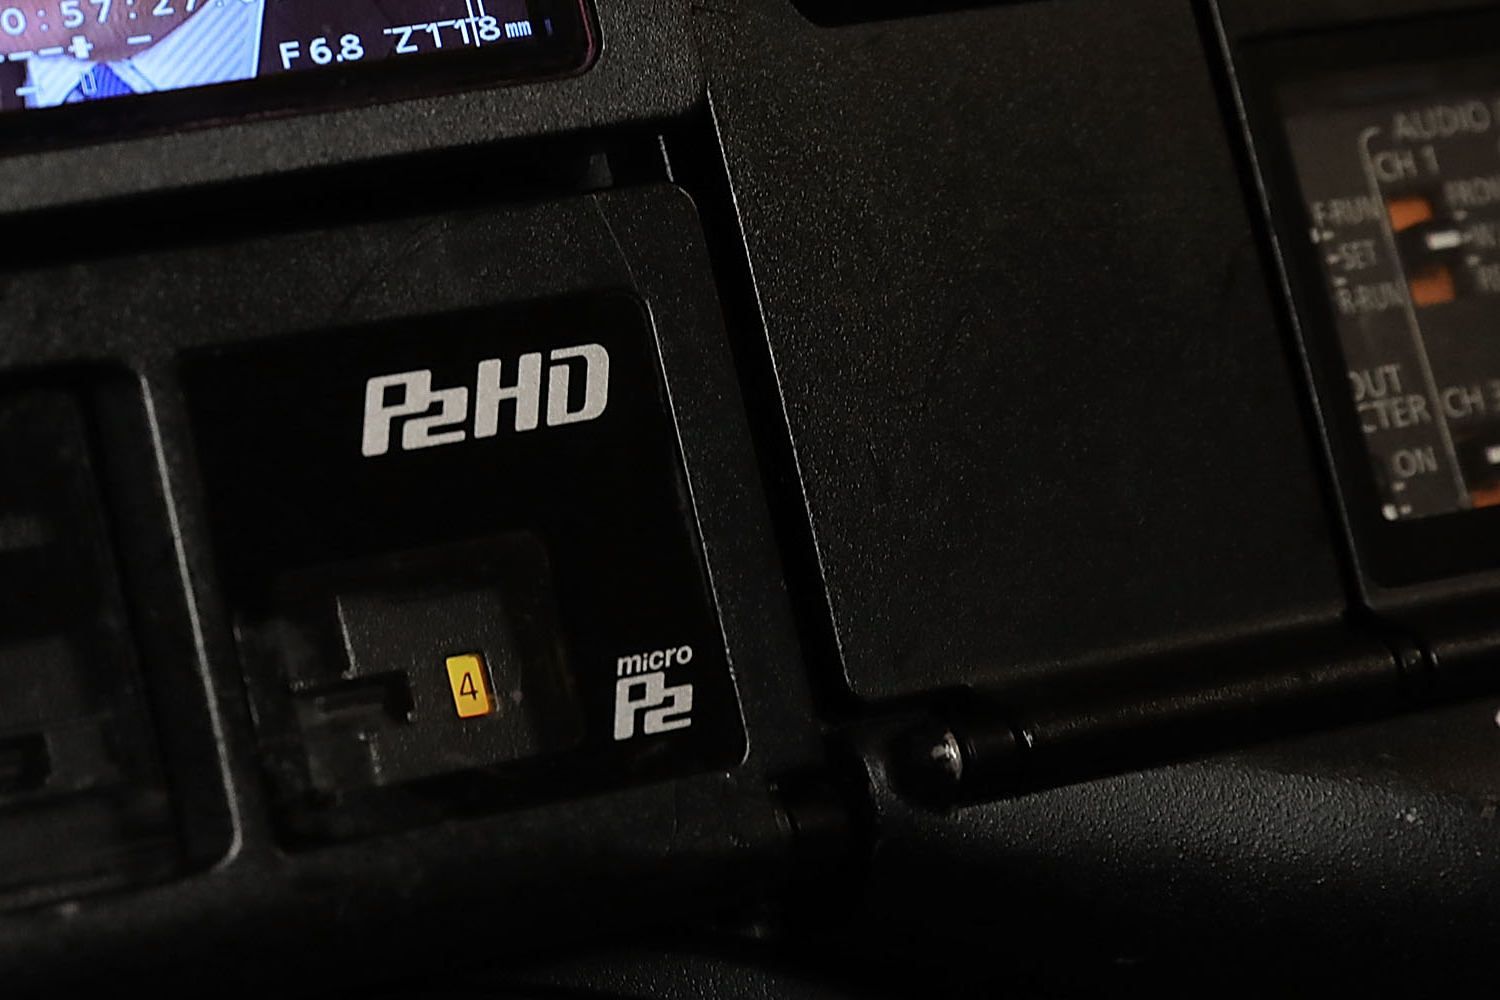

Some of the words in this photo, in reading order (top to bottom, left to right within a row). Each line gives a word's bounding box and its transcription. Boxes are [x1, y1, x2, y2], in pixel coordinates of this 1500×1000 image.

[1393, 101, 1490, 142] AUDIO
[1373, 153, 1418, 182] CH
[1392, 447, 1438, 479] ON
[617, 645, 693, 676] micro
[613, 671, 693, 741] P2
